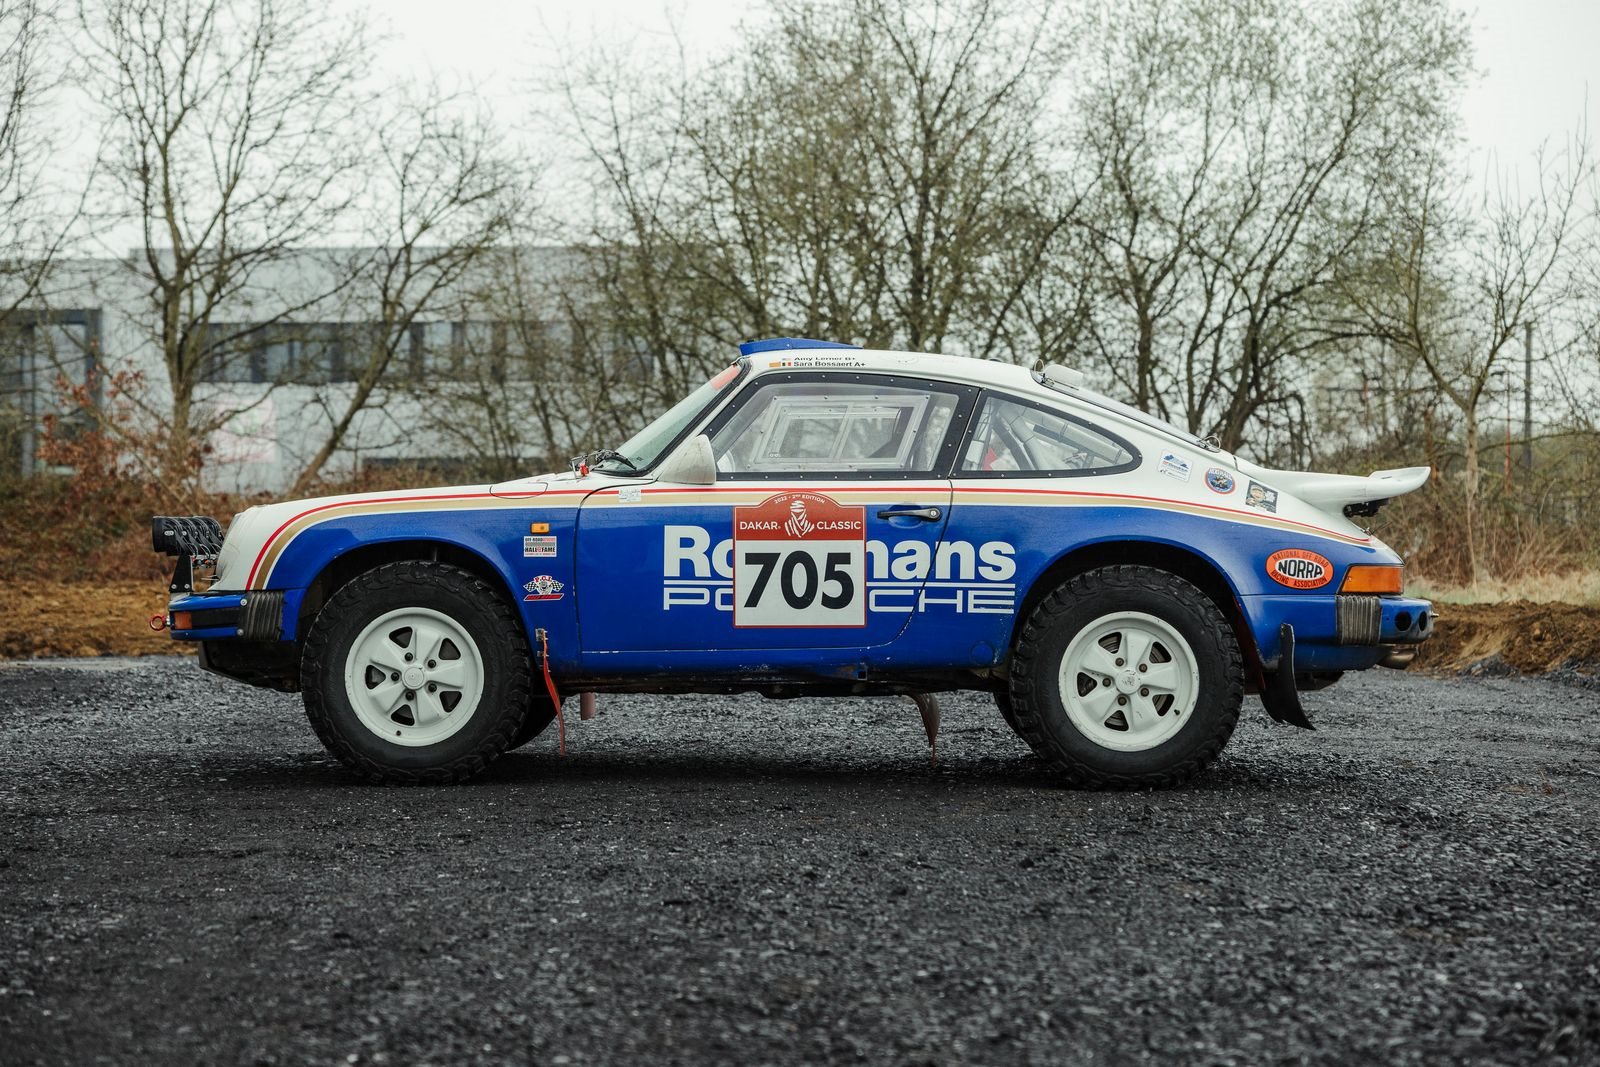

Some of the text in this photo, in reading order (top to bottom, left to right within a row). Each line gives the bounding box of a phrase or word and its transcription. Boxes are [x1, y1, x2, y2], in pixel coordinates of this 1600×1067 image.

[774, 495, 788, 504] 2022
[802, 494, 825, 504] EDITION
[740, 521, 862, 530] DAKAR CLASSIC
[1272, 551, 1299, 560] NATIONAL
[1314, 555, 1329, 567] ROAD
[1278, 559, 1323, 579] NORRA
[744, 550, 855, 610] 705
[1271, 570, 1327, 587] RACING ASSOCIATION
